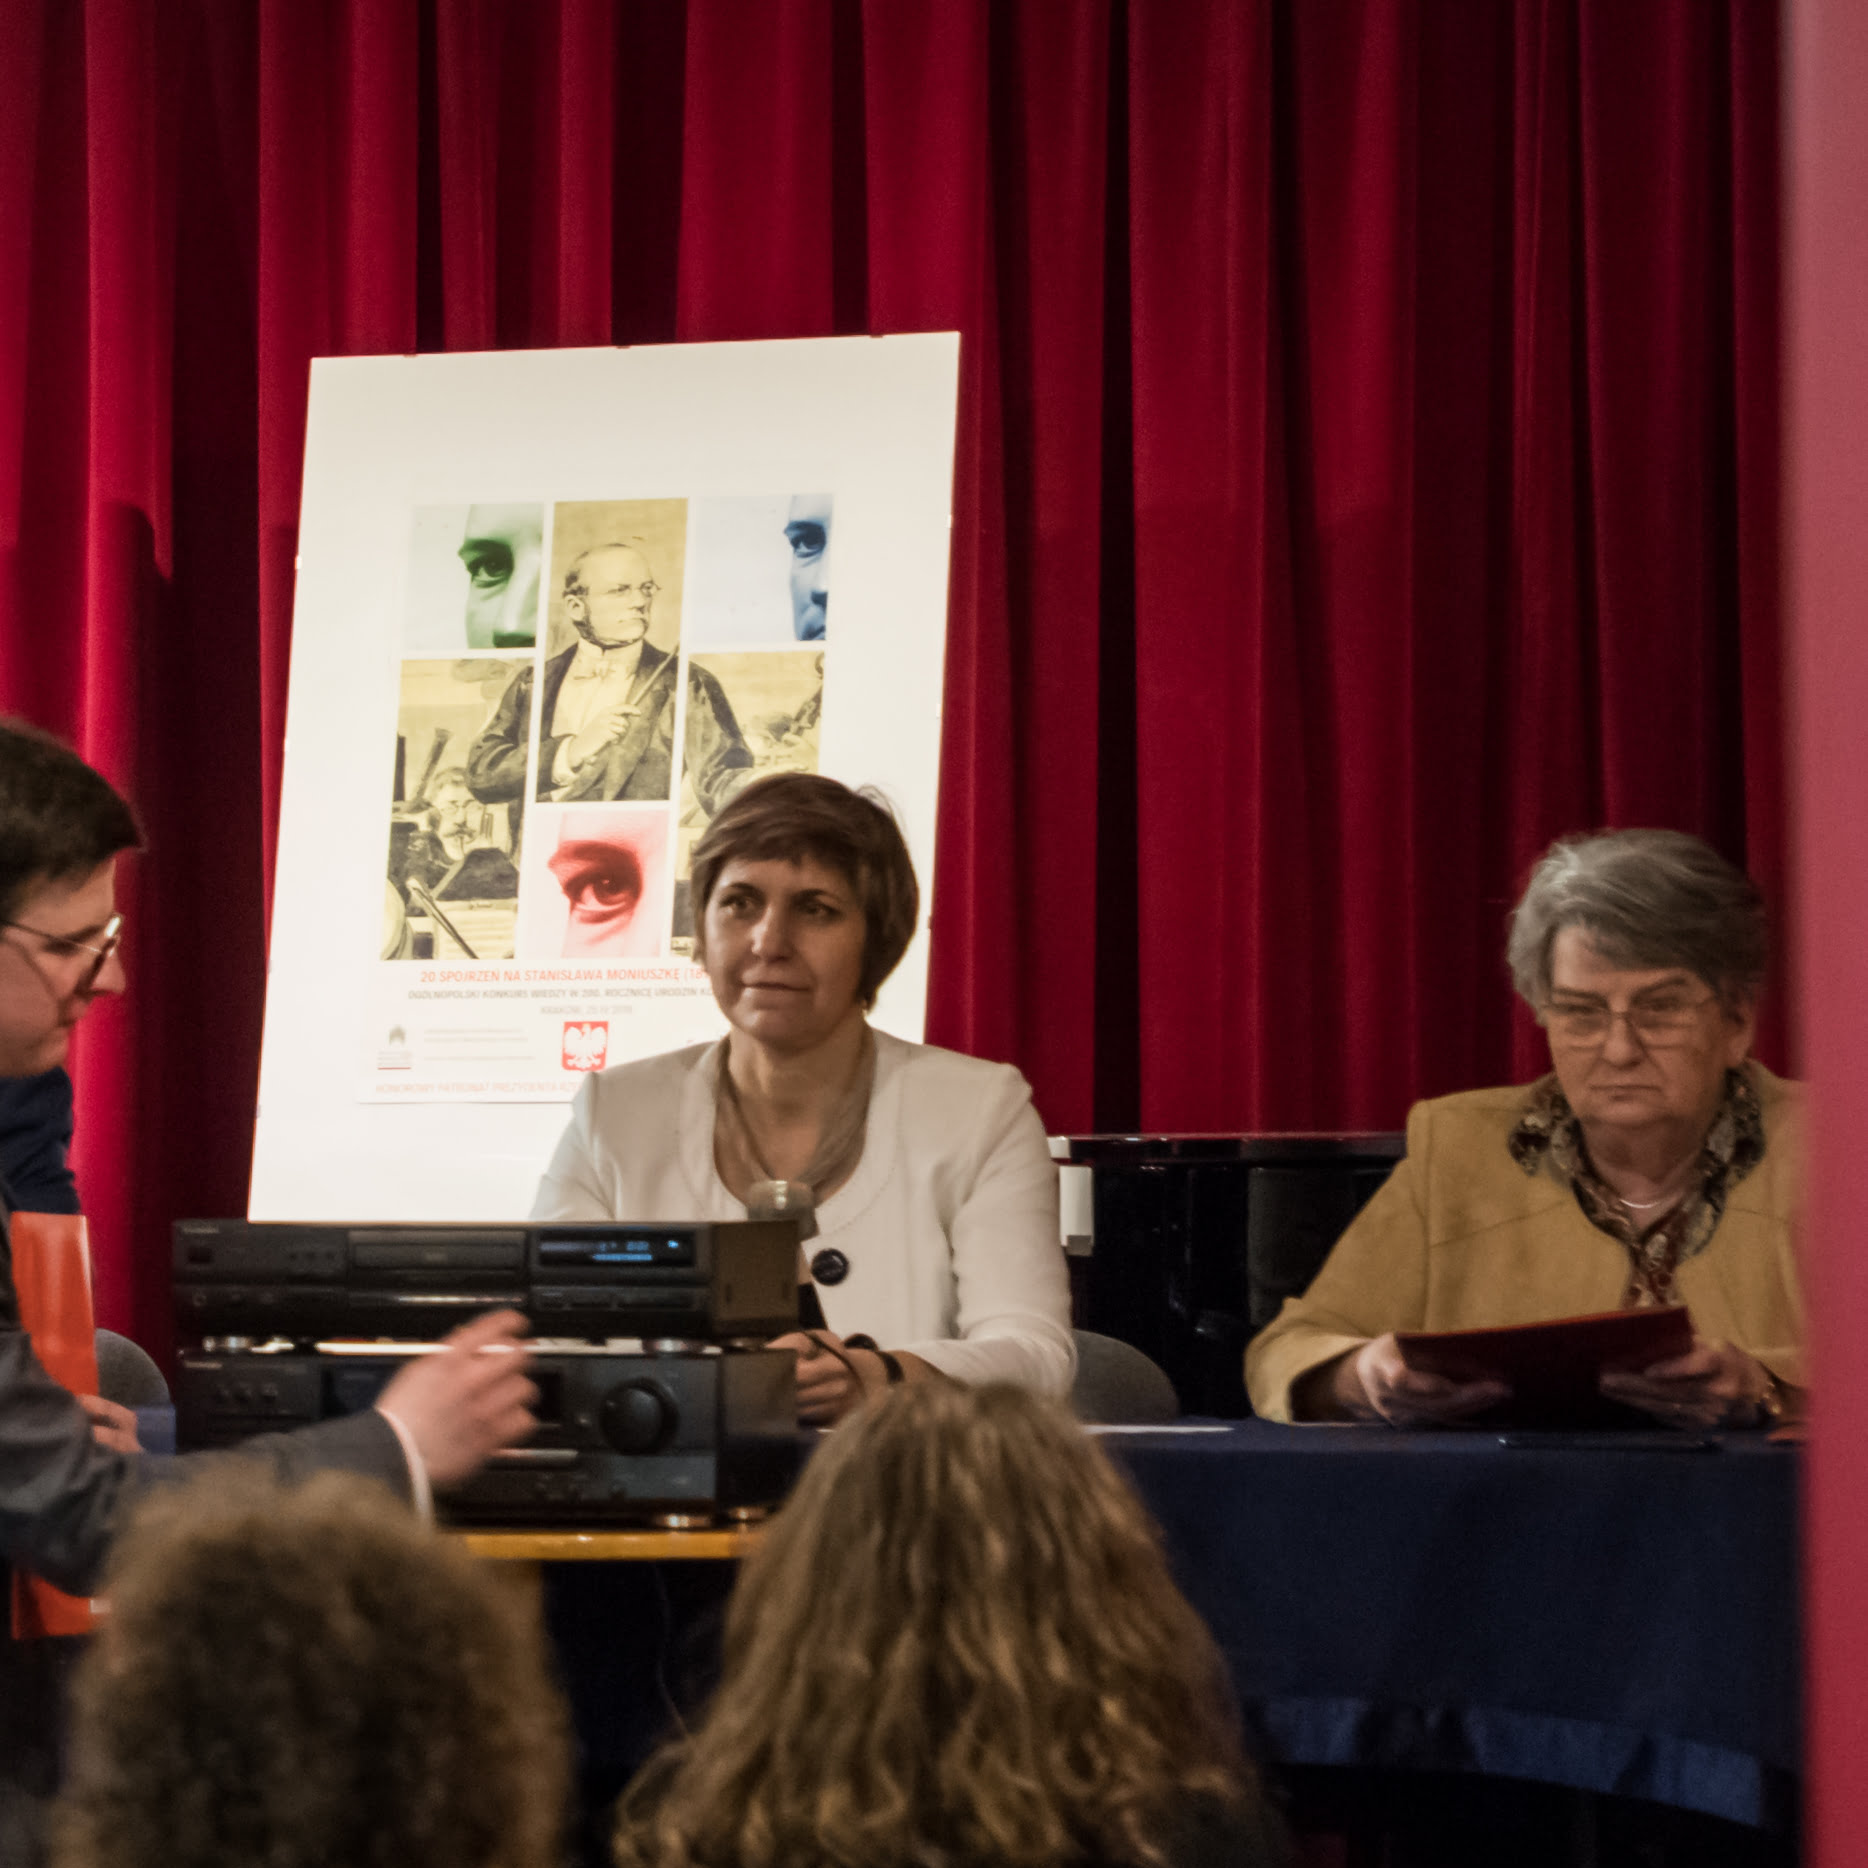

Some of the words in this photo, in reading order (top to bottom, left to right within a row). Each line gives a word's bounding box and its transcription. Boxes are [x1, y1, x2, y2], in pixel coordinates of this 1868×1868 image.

[420, 970, 436, 983] 20
[439, 968, 500, 982] SPOJRZEŃ
[503, 969, 521, 982] NA
[524, 968, 603, 981] STANISŁAWA
[607, 967, 680, 982] MONIUSZKĘ
